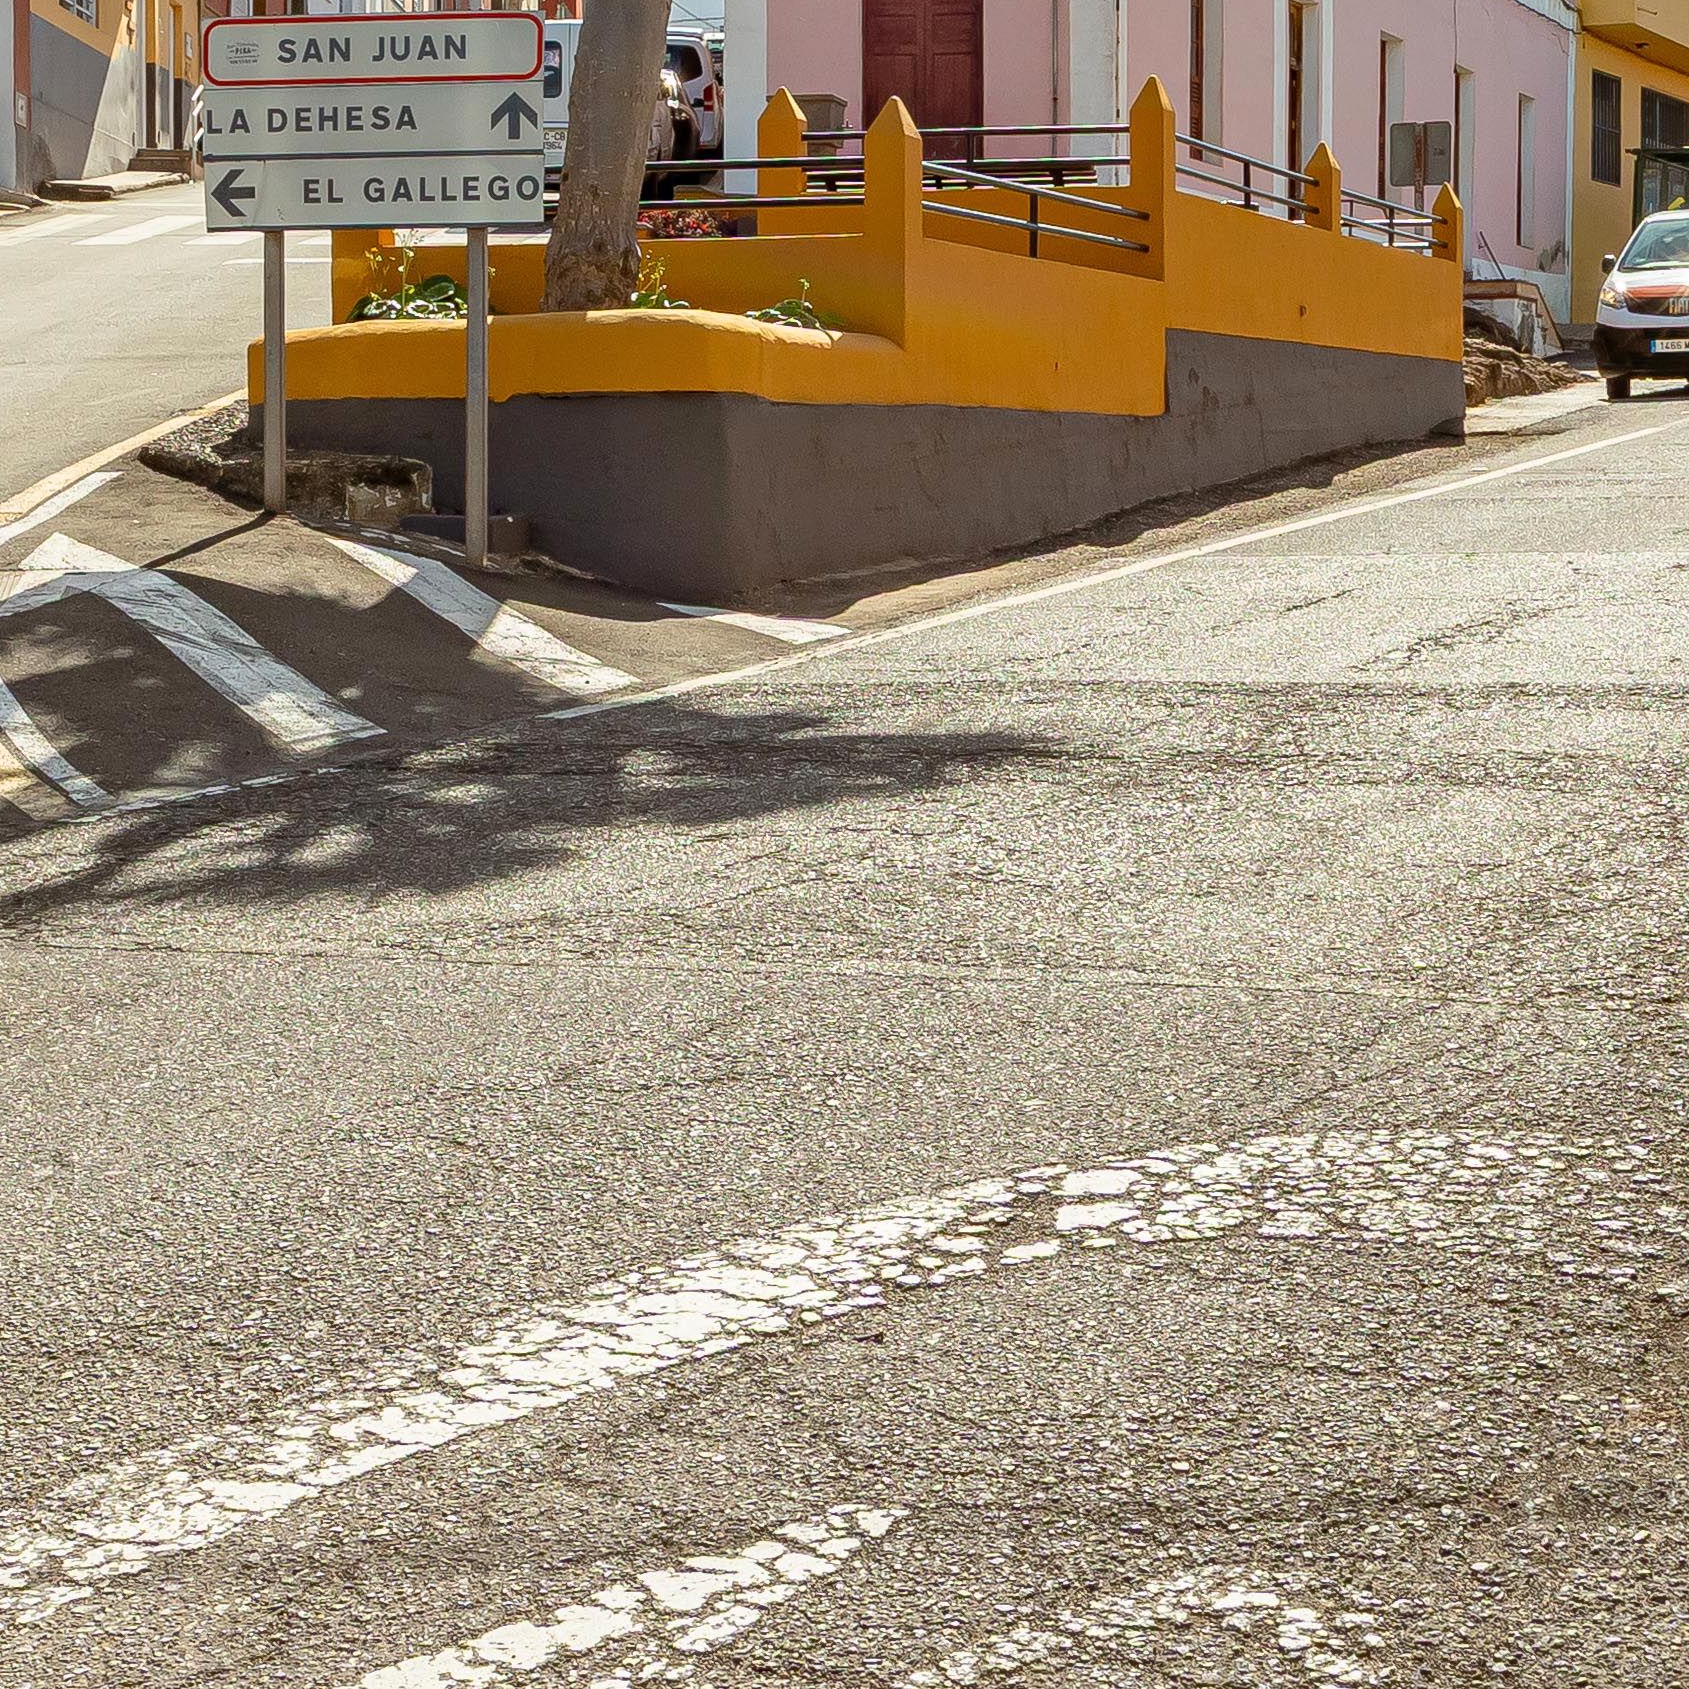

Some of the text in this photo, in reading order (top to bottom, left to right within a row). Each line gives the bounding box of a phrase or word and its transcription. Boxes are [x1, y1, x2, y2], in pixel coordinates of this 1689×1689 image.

[277, 34, 467, 63] SAN JUAN
[206, 105, 418, 135] LA DEHESA
[303, 175, 540, 204] EL GALLEGO
